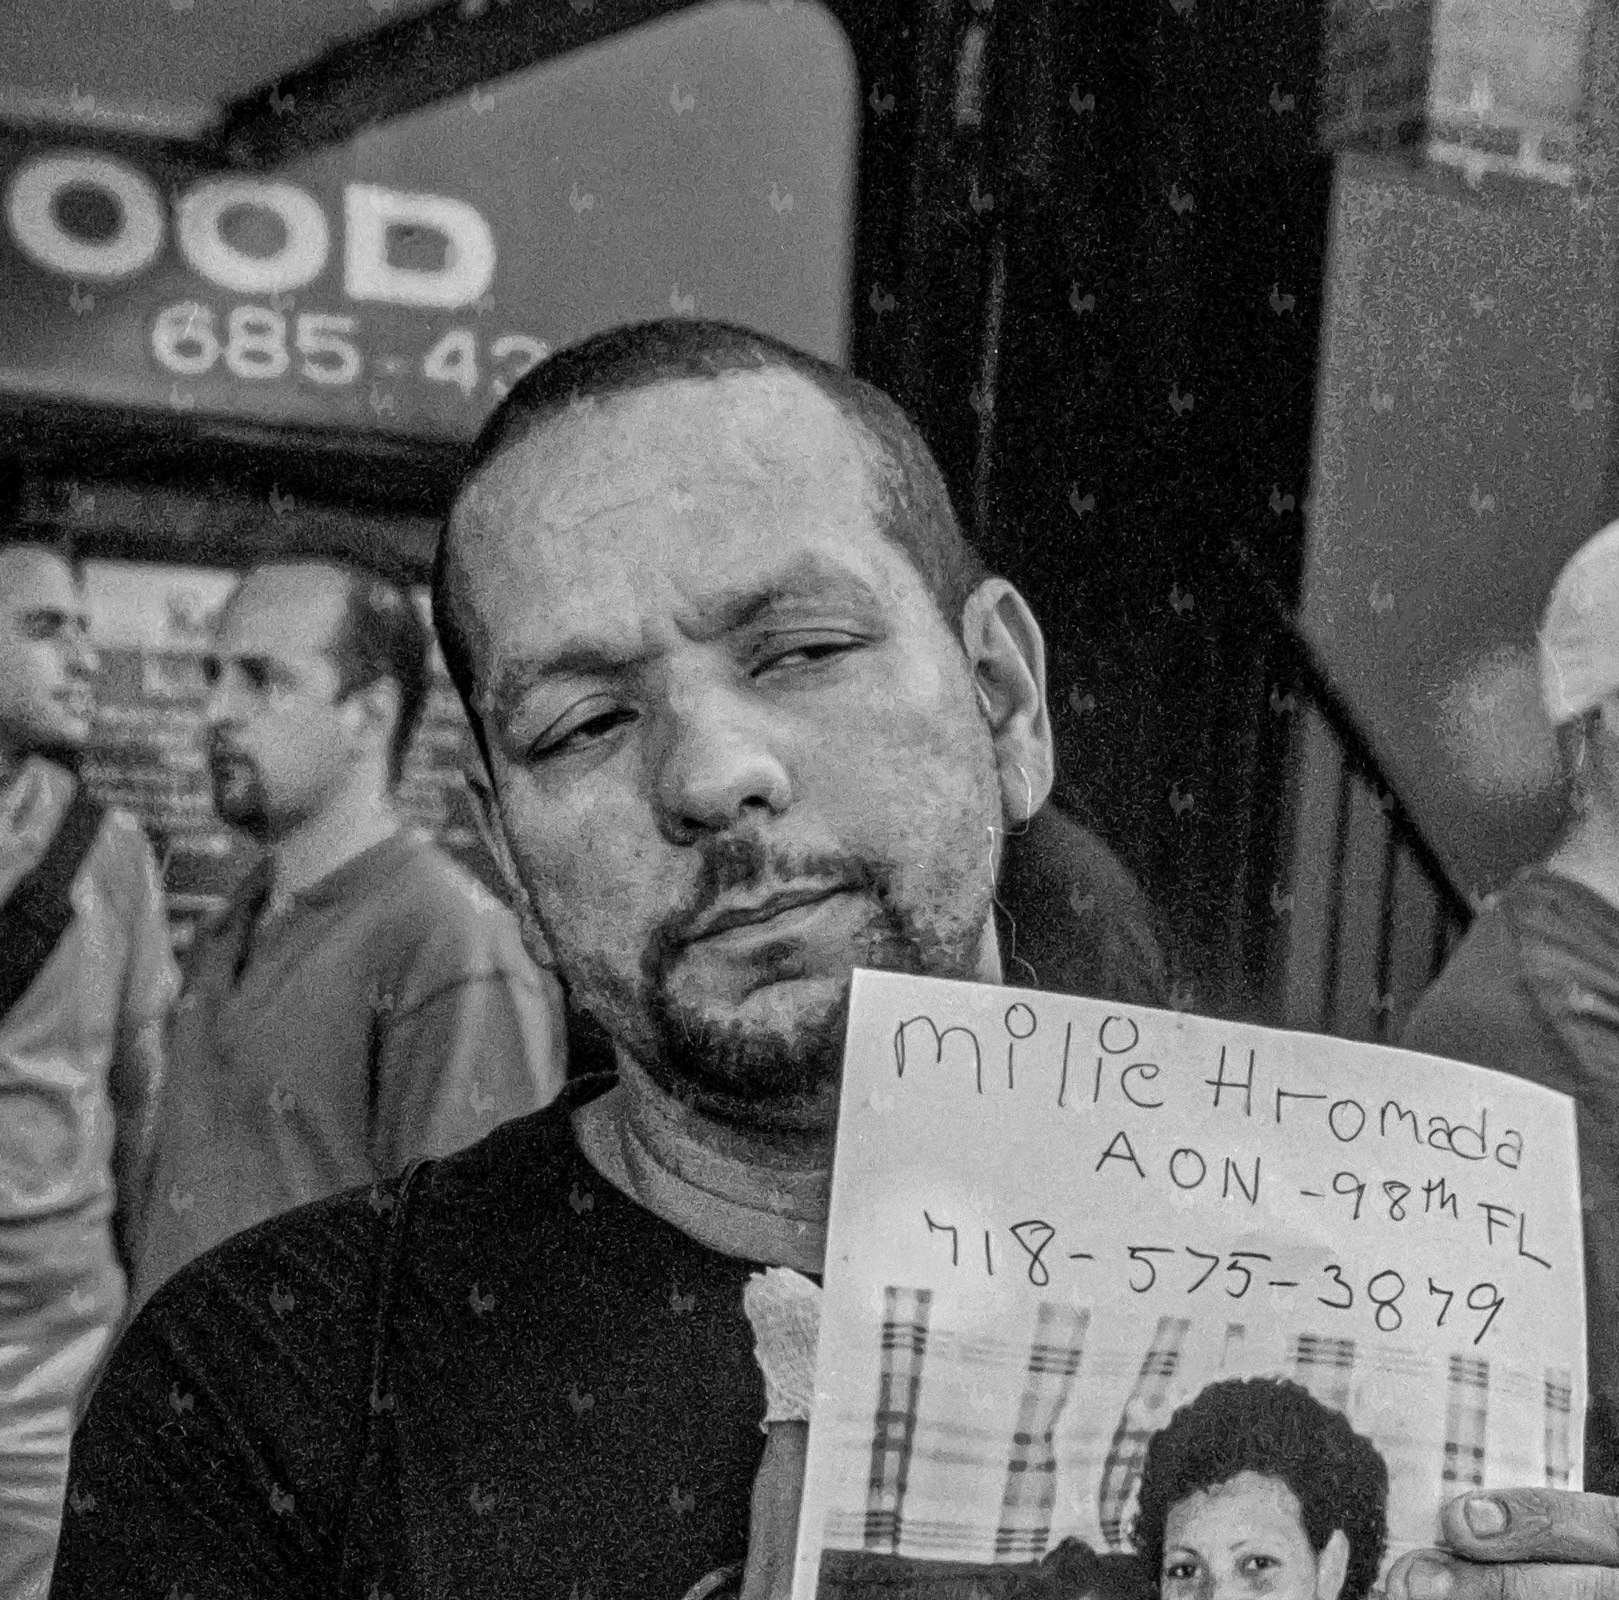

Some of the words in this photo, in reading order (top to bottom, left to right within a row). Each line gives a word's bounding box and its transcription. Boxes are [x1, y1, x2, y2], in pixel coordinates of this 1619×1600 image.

[1204, 1045, 1525, 1171] Hromada
[1094, 1130, 1262, 1206] AON
[1476, 1201, 1554, 1270] FL
